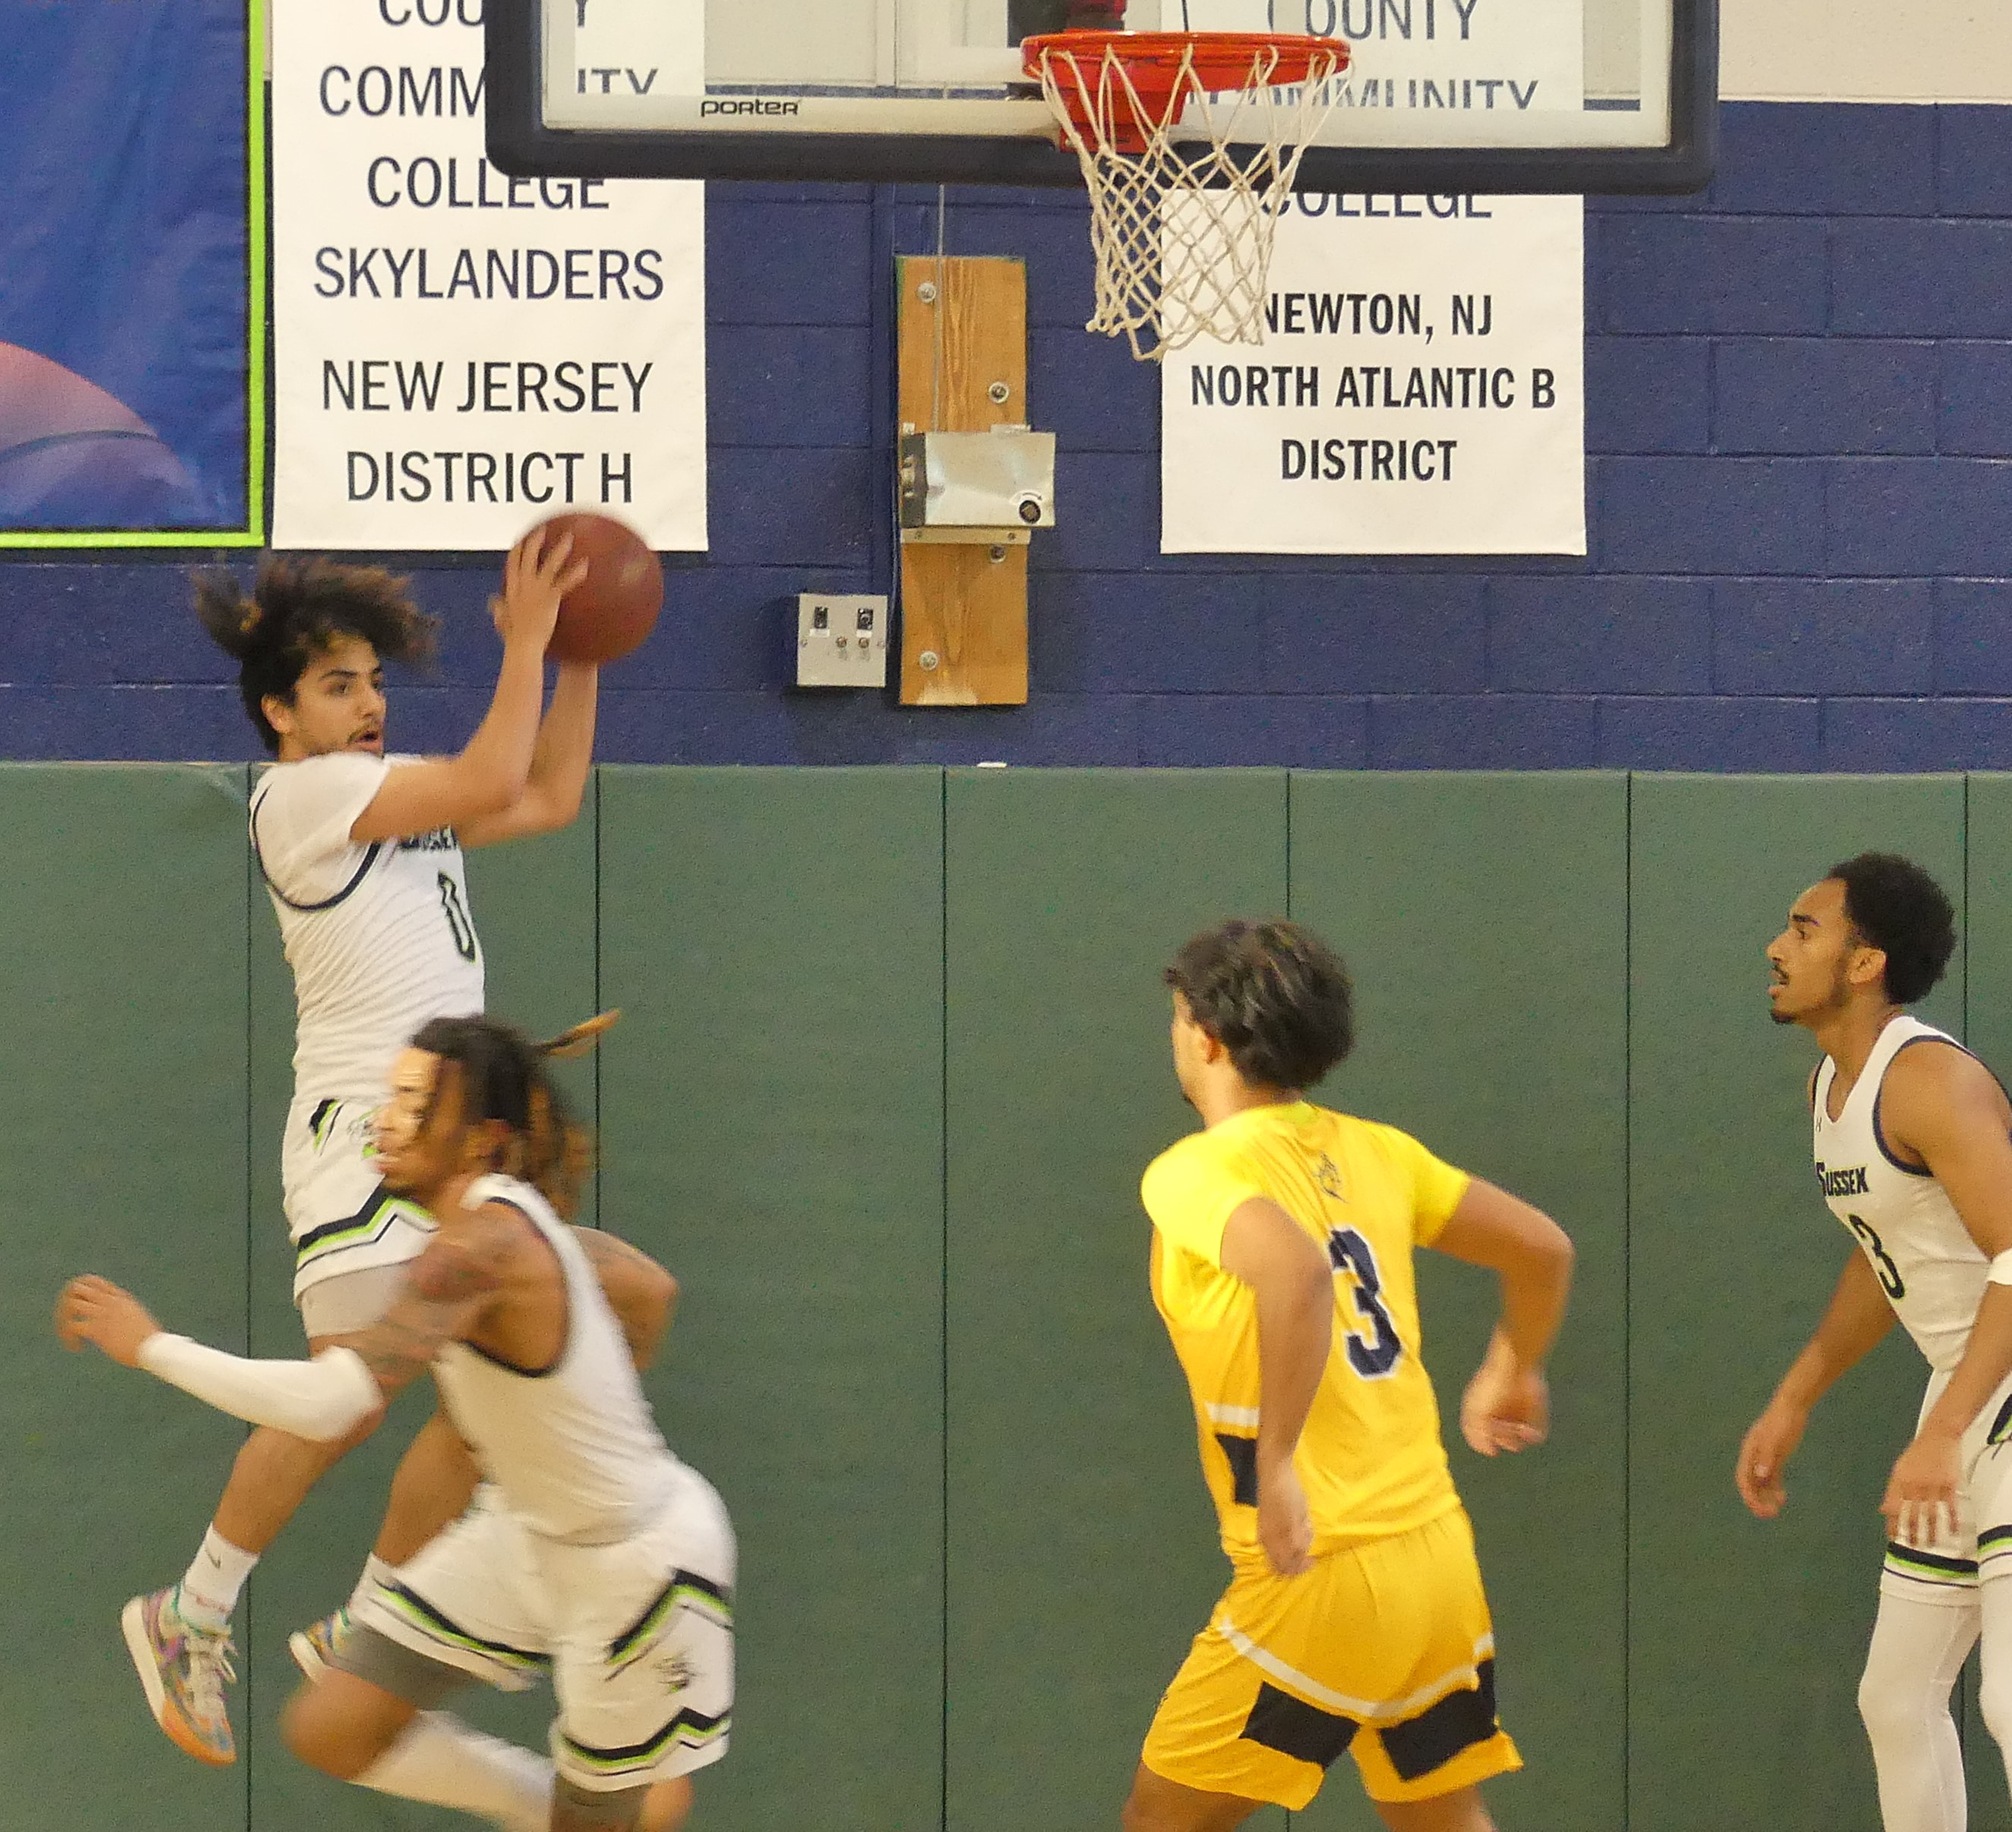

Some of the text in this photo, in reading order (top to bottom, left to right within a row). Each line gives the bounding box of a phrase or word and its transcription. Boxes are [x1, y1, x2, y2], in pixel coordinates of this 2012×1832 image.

[1210, 77, 1539, 109] MUNITY
[367, 156, 610, 210] COLLEGE
[314, 246, 664, 301] SKYLANDERS
[1264, 292, 1493, 344] NEWTON, NJ
[323, 360, 653, 413] NEW JERSEY
[1191, 365, 1556, 409] NORTH ATLANTIC B
[347, 451, 632, 503] DISTRICT H
[1281, 439, 1457, 481] DISTRICT
[437, 870, 476, 962] 0
[1815, 1161, 1870, 1197] SUSSEX
[1848, 1213, 1905, 1300] 3
[1327, 1226, 1402, 1378] 3
